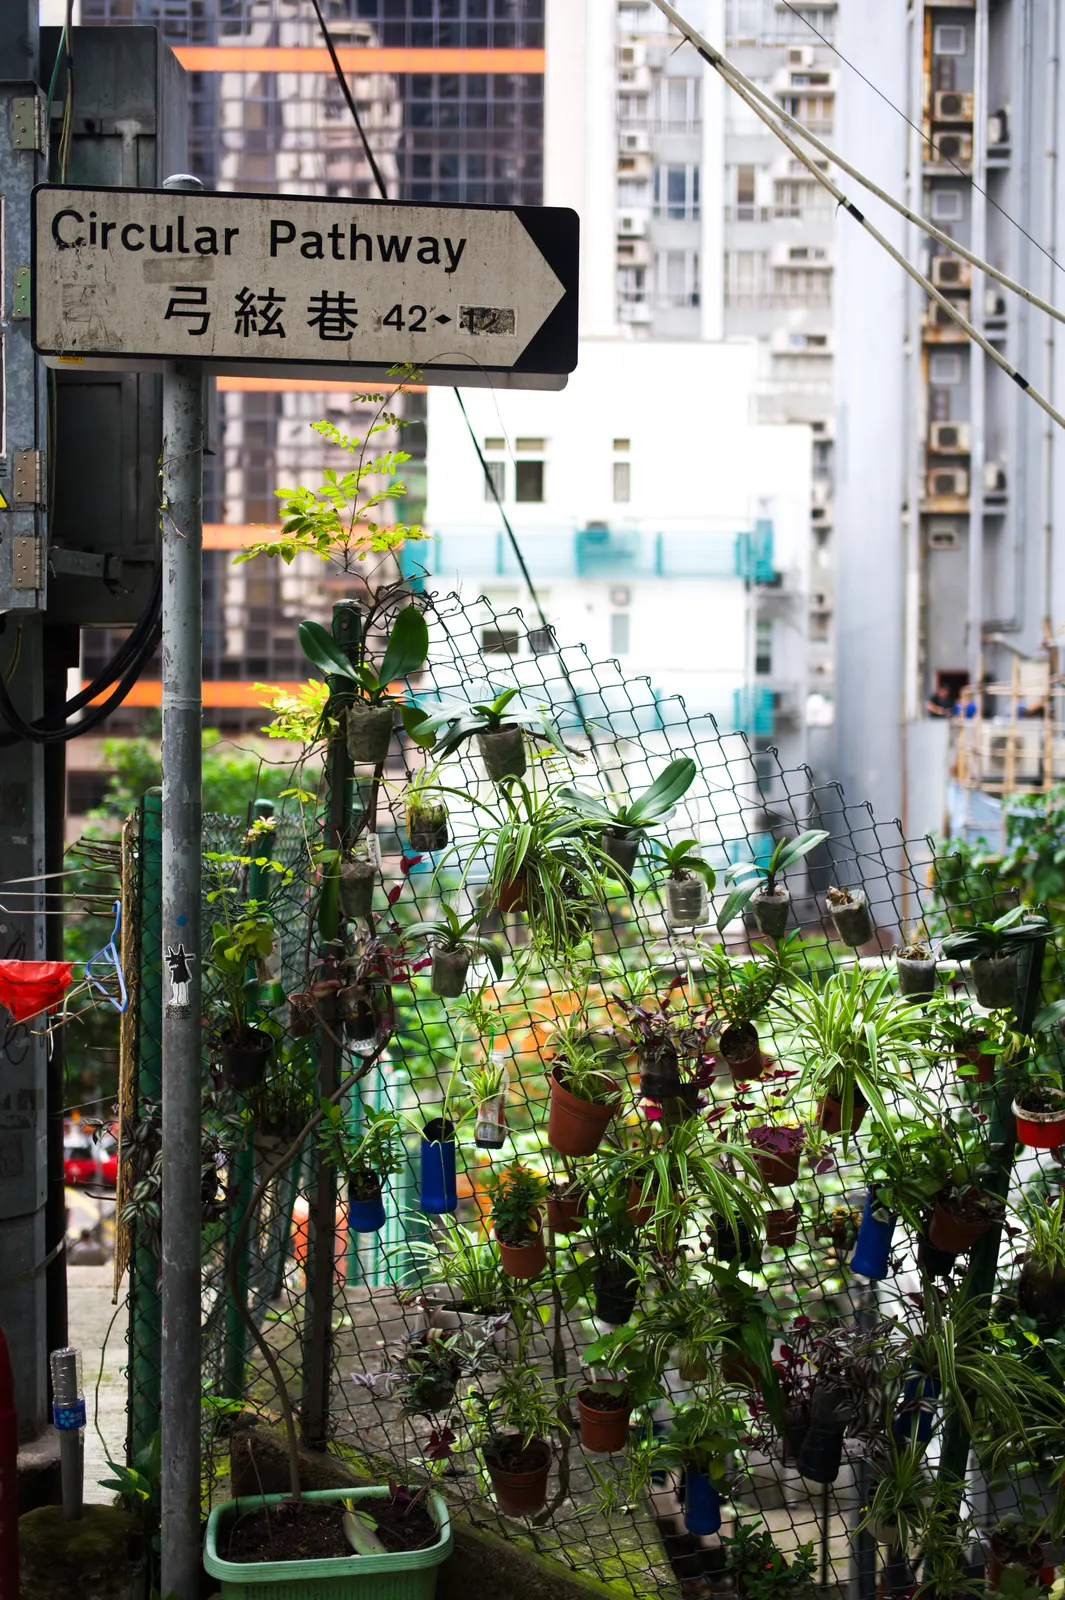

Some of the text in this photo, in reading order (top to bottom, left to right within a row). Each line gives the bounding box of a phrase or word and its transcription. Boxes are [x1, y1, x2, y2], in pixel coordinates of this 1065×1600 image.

[51, 209, 467, 273] Circular Pathway
[164, 286, 359, 341] 弓絃巷
[382, 304, 428, 332] 42
